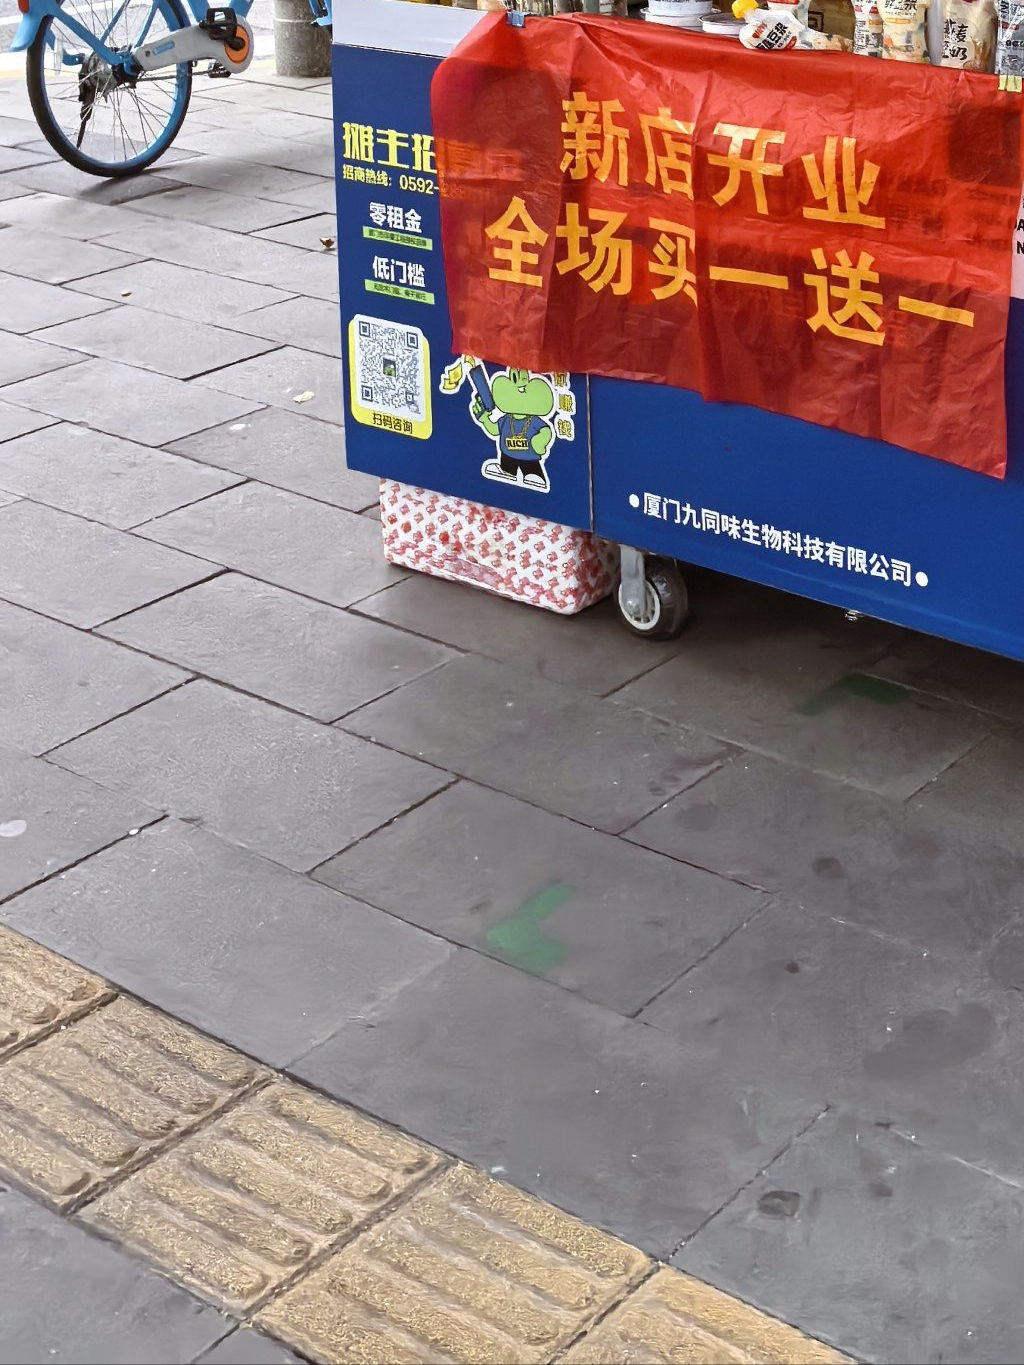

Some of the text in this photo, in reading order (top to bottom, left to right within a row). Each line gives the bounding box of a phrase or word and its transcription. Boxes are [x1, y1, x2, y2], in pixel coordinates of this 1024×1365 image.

[559, 91, 886, 230] 新店开业
[369, 201, 422, 234] 零租金
[372, 255, 426, 288] 低门槛
[484, 195, 975, 346] 全场买一送一
[372, 413, 413, 435] 扫码咨询
[506, 438, 529, 449] RICH
[643, 492, 912, 587] 厦门九同味生物科技有限公司
